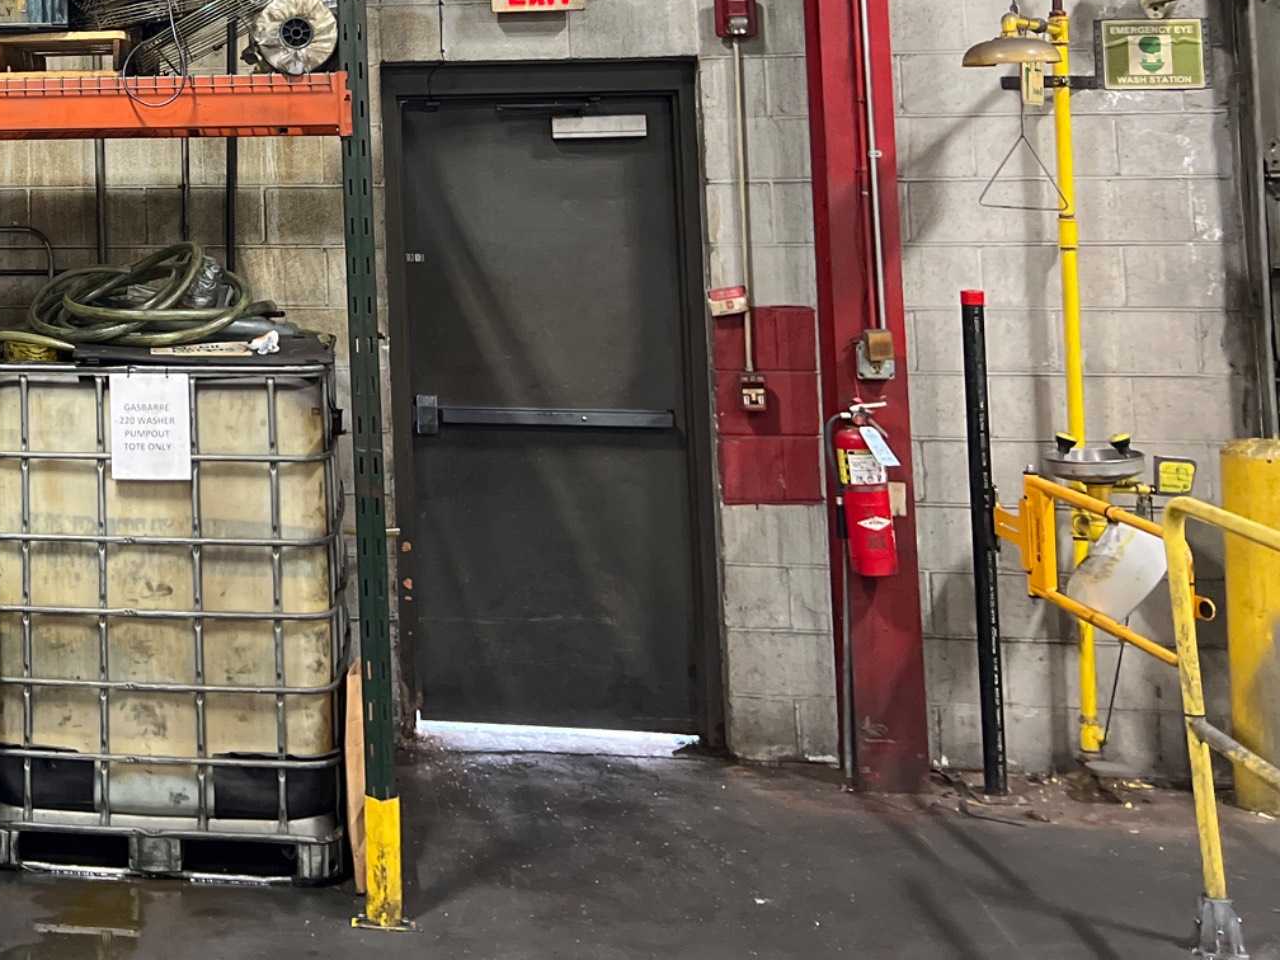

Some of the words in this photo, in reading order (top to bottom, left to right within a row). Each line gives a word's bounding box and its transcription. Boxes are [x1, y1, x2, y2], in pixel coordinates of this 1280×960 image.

[1109, 26, 1171, 35] EMERGENCY
[1173, 25, 1193, 34] EYE
[1117, 76, 1146, 84] WASH
[1149, 75, 1192, 83] STATION
[138, 416, 175, 425] WASHER
[124, 429, 171, 438] PUMPOUT
[124, 442, 145, 451] TOTE
[148, 442, 172, 451] ONLY
